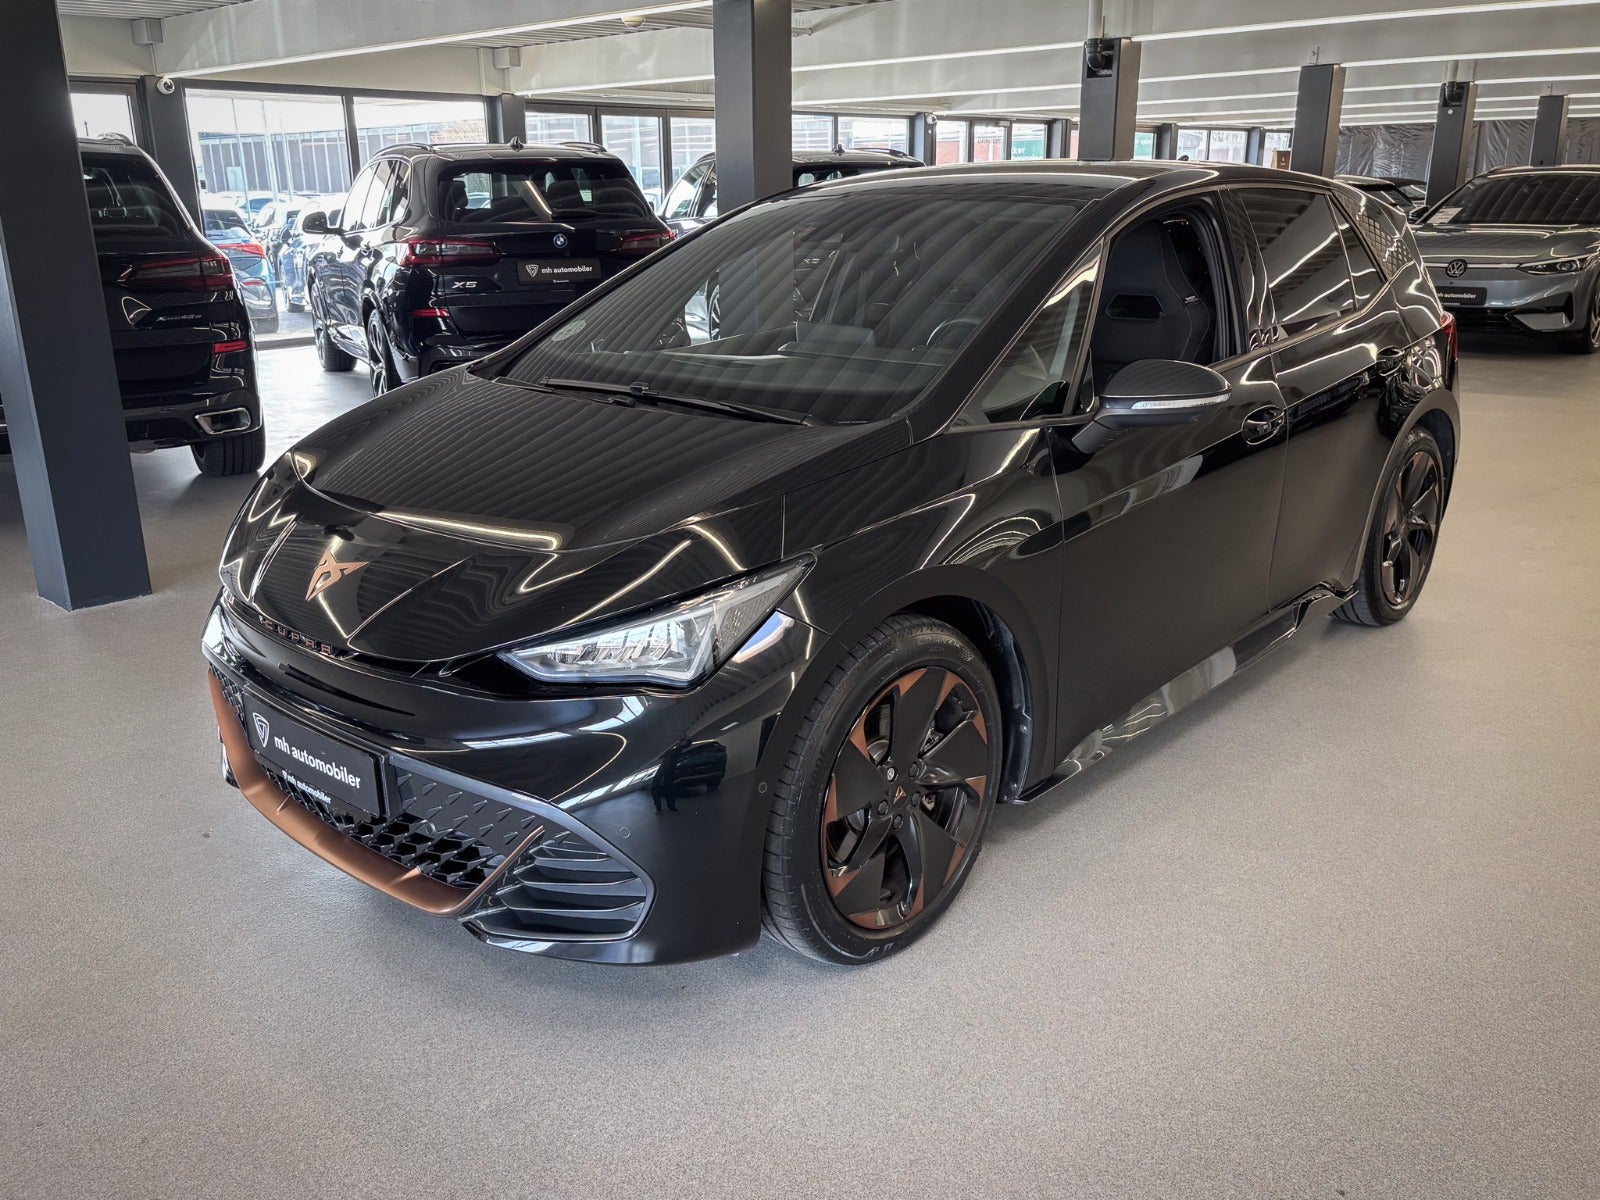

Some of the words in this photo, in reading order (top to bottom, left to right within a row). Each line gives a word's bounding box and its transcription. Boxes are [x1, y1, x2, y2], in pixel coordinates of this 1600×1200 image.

[554, 265, 593, 273] automobiler
[451, 281, 478, 289] X5
[264, 619, 332, 655] CUPRA
[274, 736, 291, 755] mh
[291, 746, 361, 789] automobiler
